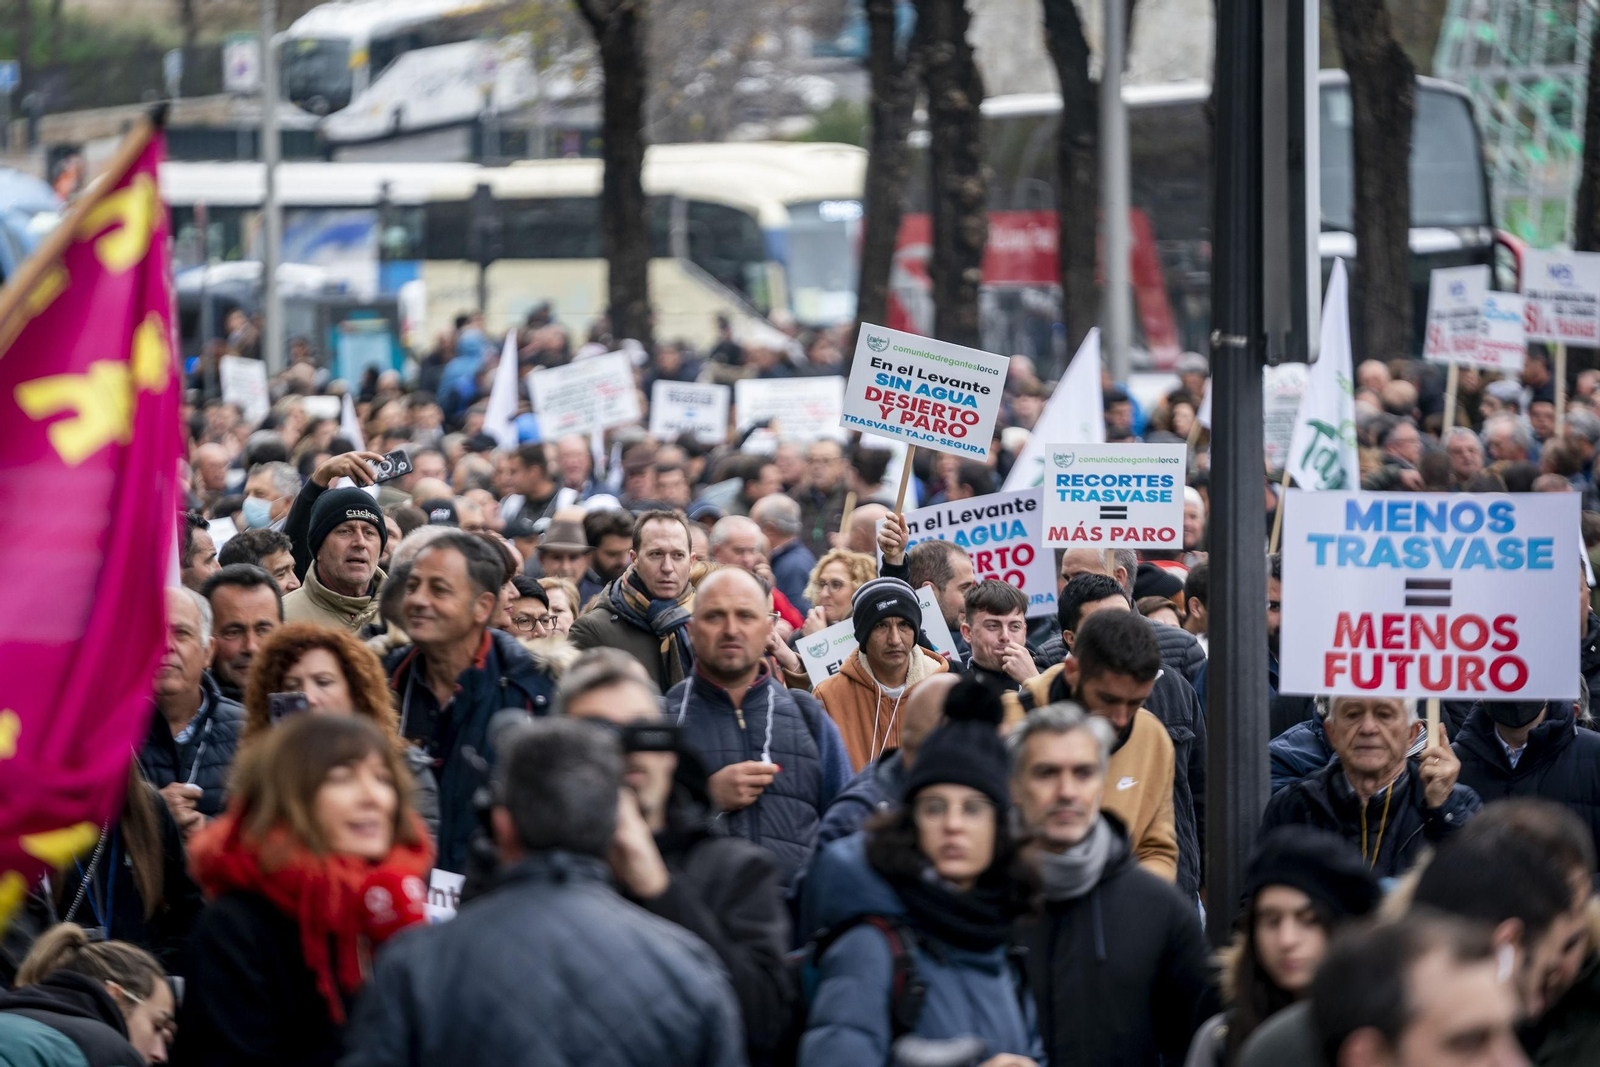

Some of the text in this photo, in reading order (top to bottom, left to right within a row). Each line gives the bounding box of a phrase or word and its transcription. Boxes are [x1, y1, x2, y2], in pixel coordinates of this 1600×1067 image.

[870, 357, 991, 395] En el Levante
[893, 344, 999, 375] comunidadreganteslorca
[864, 386, 980, 426] DESIERTO
[875, 372, 978, 408] SIN AGUA
[843, 414, 986, 455] TRASVASE TAJO-SEGURA
[878, 405, 967, 438] Y PARO
[1078, 456, 1179, 465] comunidadreganteslorca
[1056, 474, 1174, 488] RECORTES
[1056, 489, 1172, 503] TRASVASE
[924, 511, 942, 531] el
[948, 497, 1037, 526] Levante
[1345, 498, 1516, 533] MENOS
[954, 519, 1028, 548] AGUA
[1048, 521, 1176, 542] MÁS PARO
[1307, 533, 1555, 570] TRASVASE
[1333, 611, 1520, 651] MENOS
[1324, 651, 1529, 693] FUTURO
